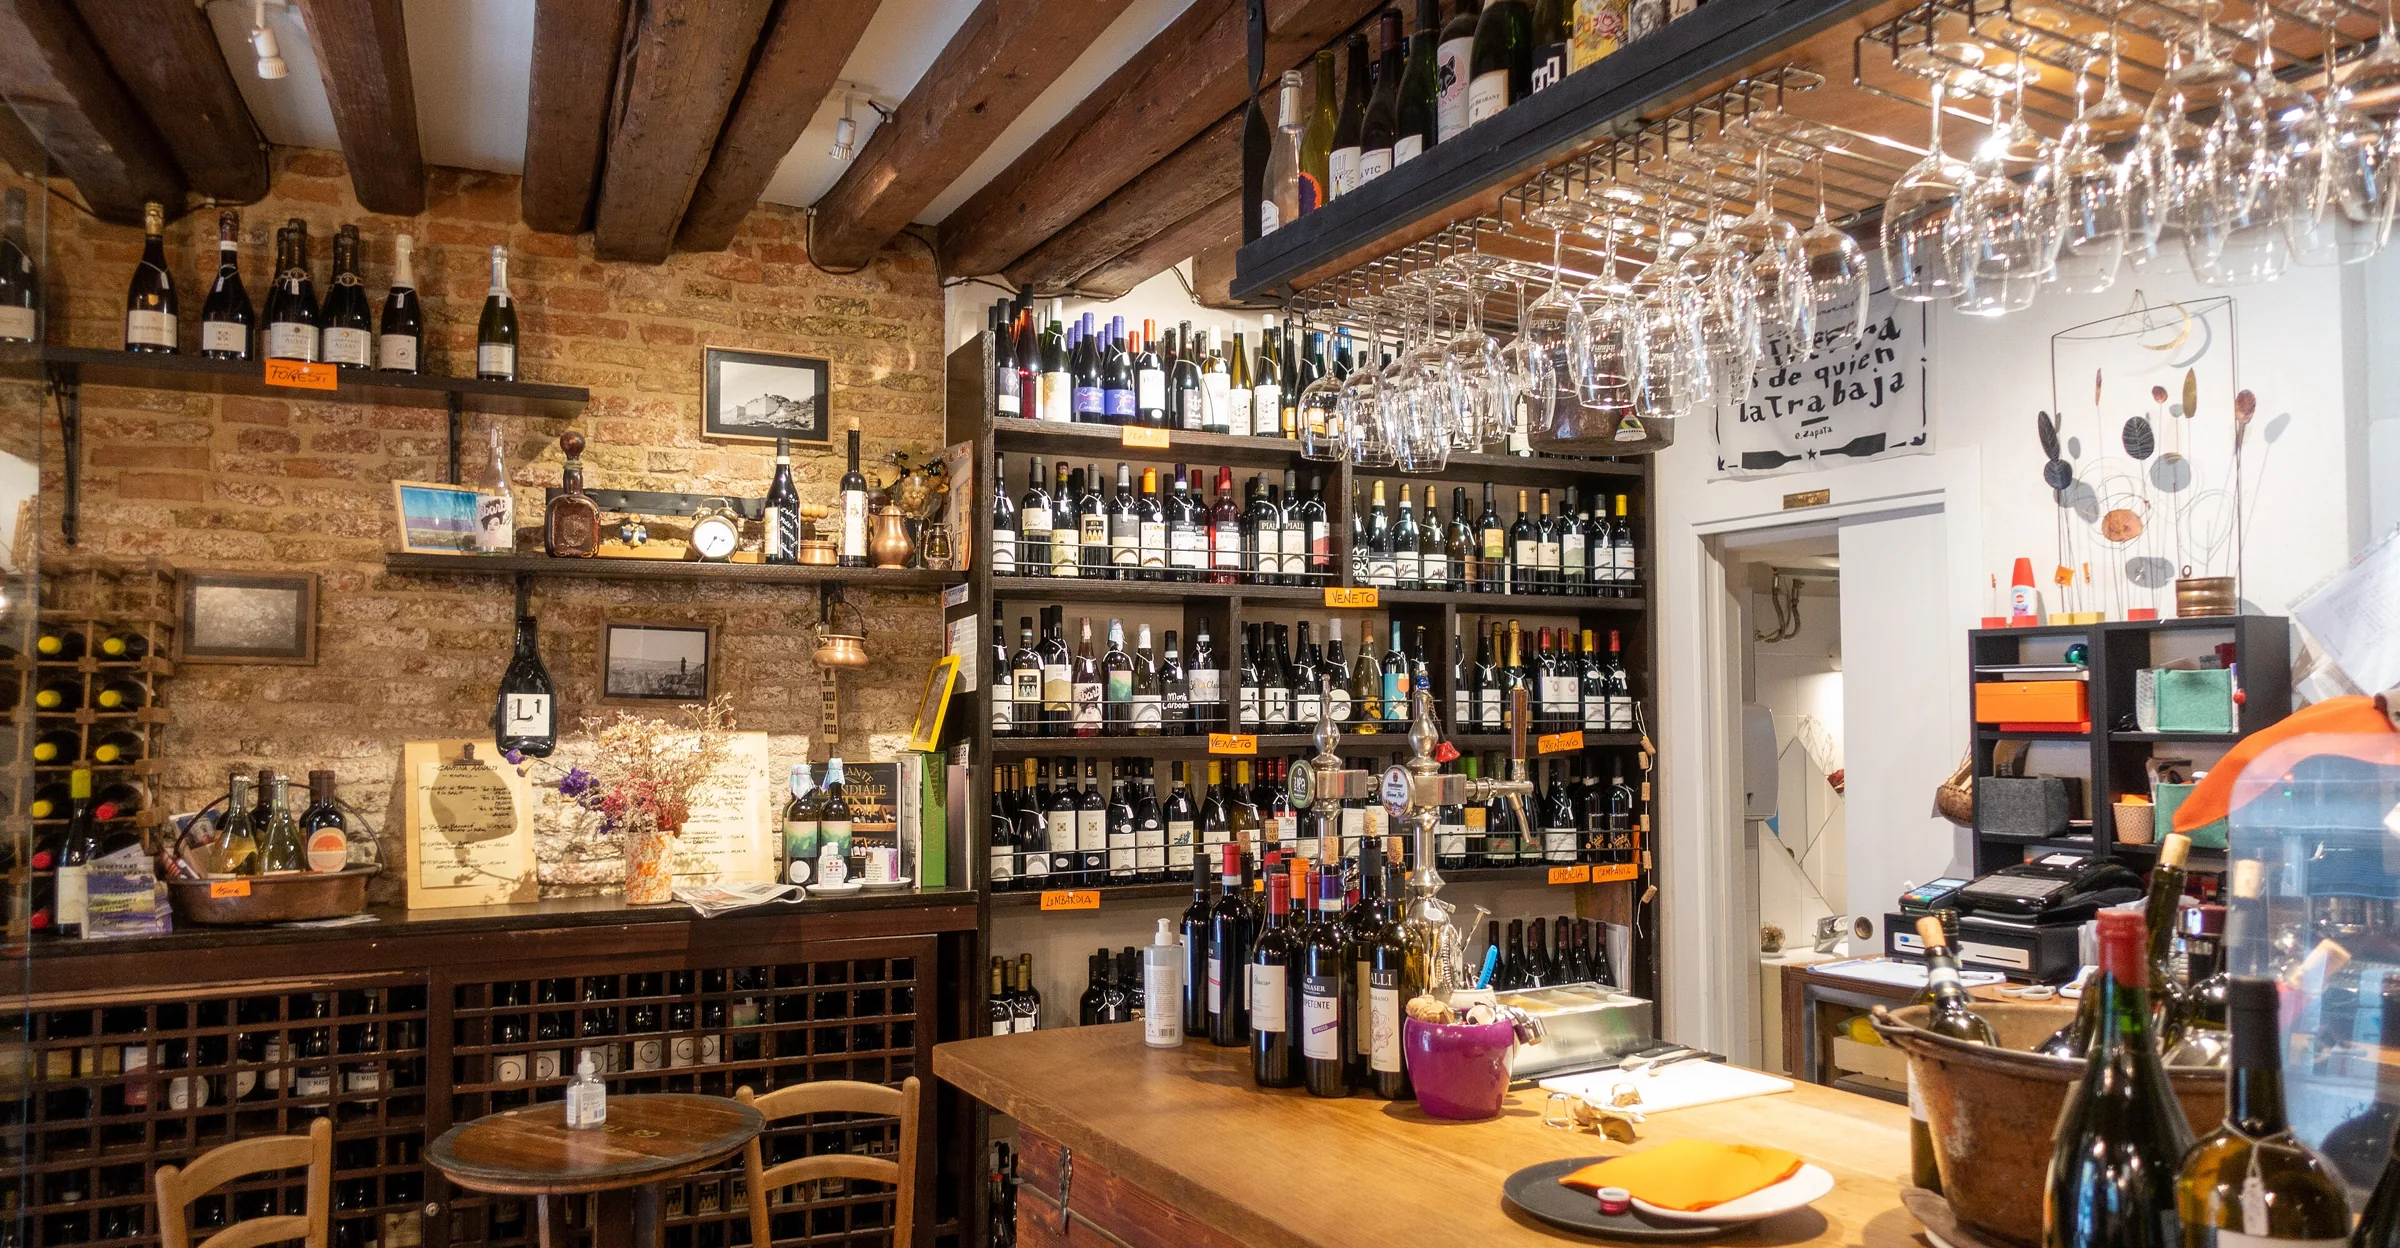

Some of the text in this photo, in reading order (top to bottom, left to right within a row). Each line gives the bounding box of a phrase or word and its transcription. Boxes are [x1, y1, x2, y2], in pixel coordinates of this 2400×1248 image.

[1769, 368, 1802, 388] de
[1814, 347, 1895, 389] quien
[1332, 590, 1376, 604] VENETO
[824, 723, 838, 735] BEER
[1210, 736, 1252, 749] VENETO
[1540, 734, 1579, 750] TRENTINO
[817, 784, 887, 796] MNDIALE
[1553, 868, 1583, 881] UMBRIA
[1597, 866, 1631, 879] CAMPANIA
[1045, 895, 1093, 907] LOMBARDIA
